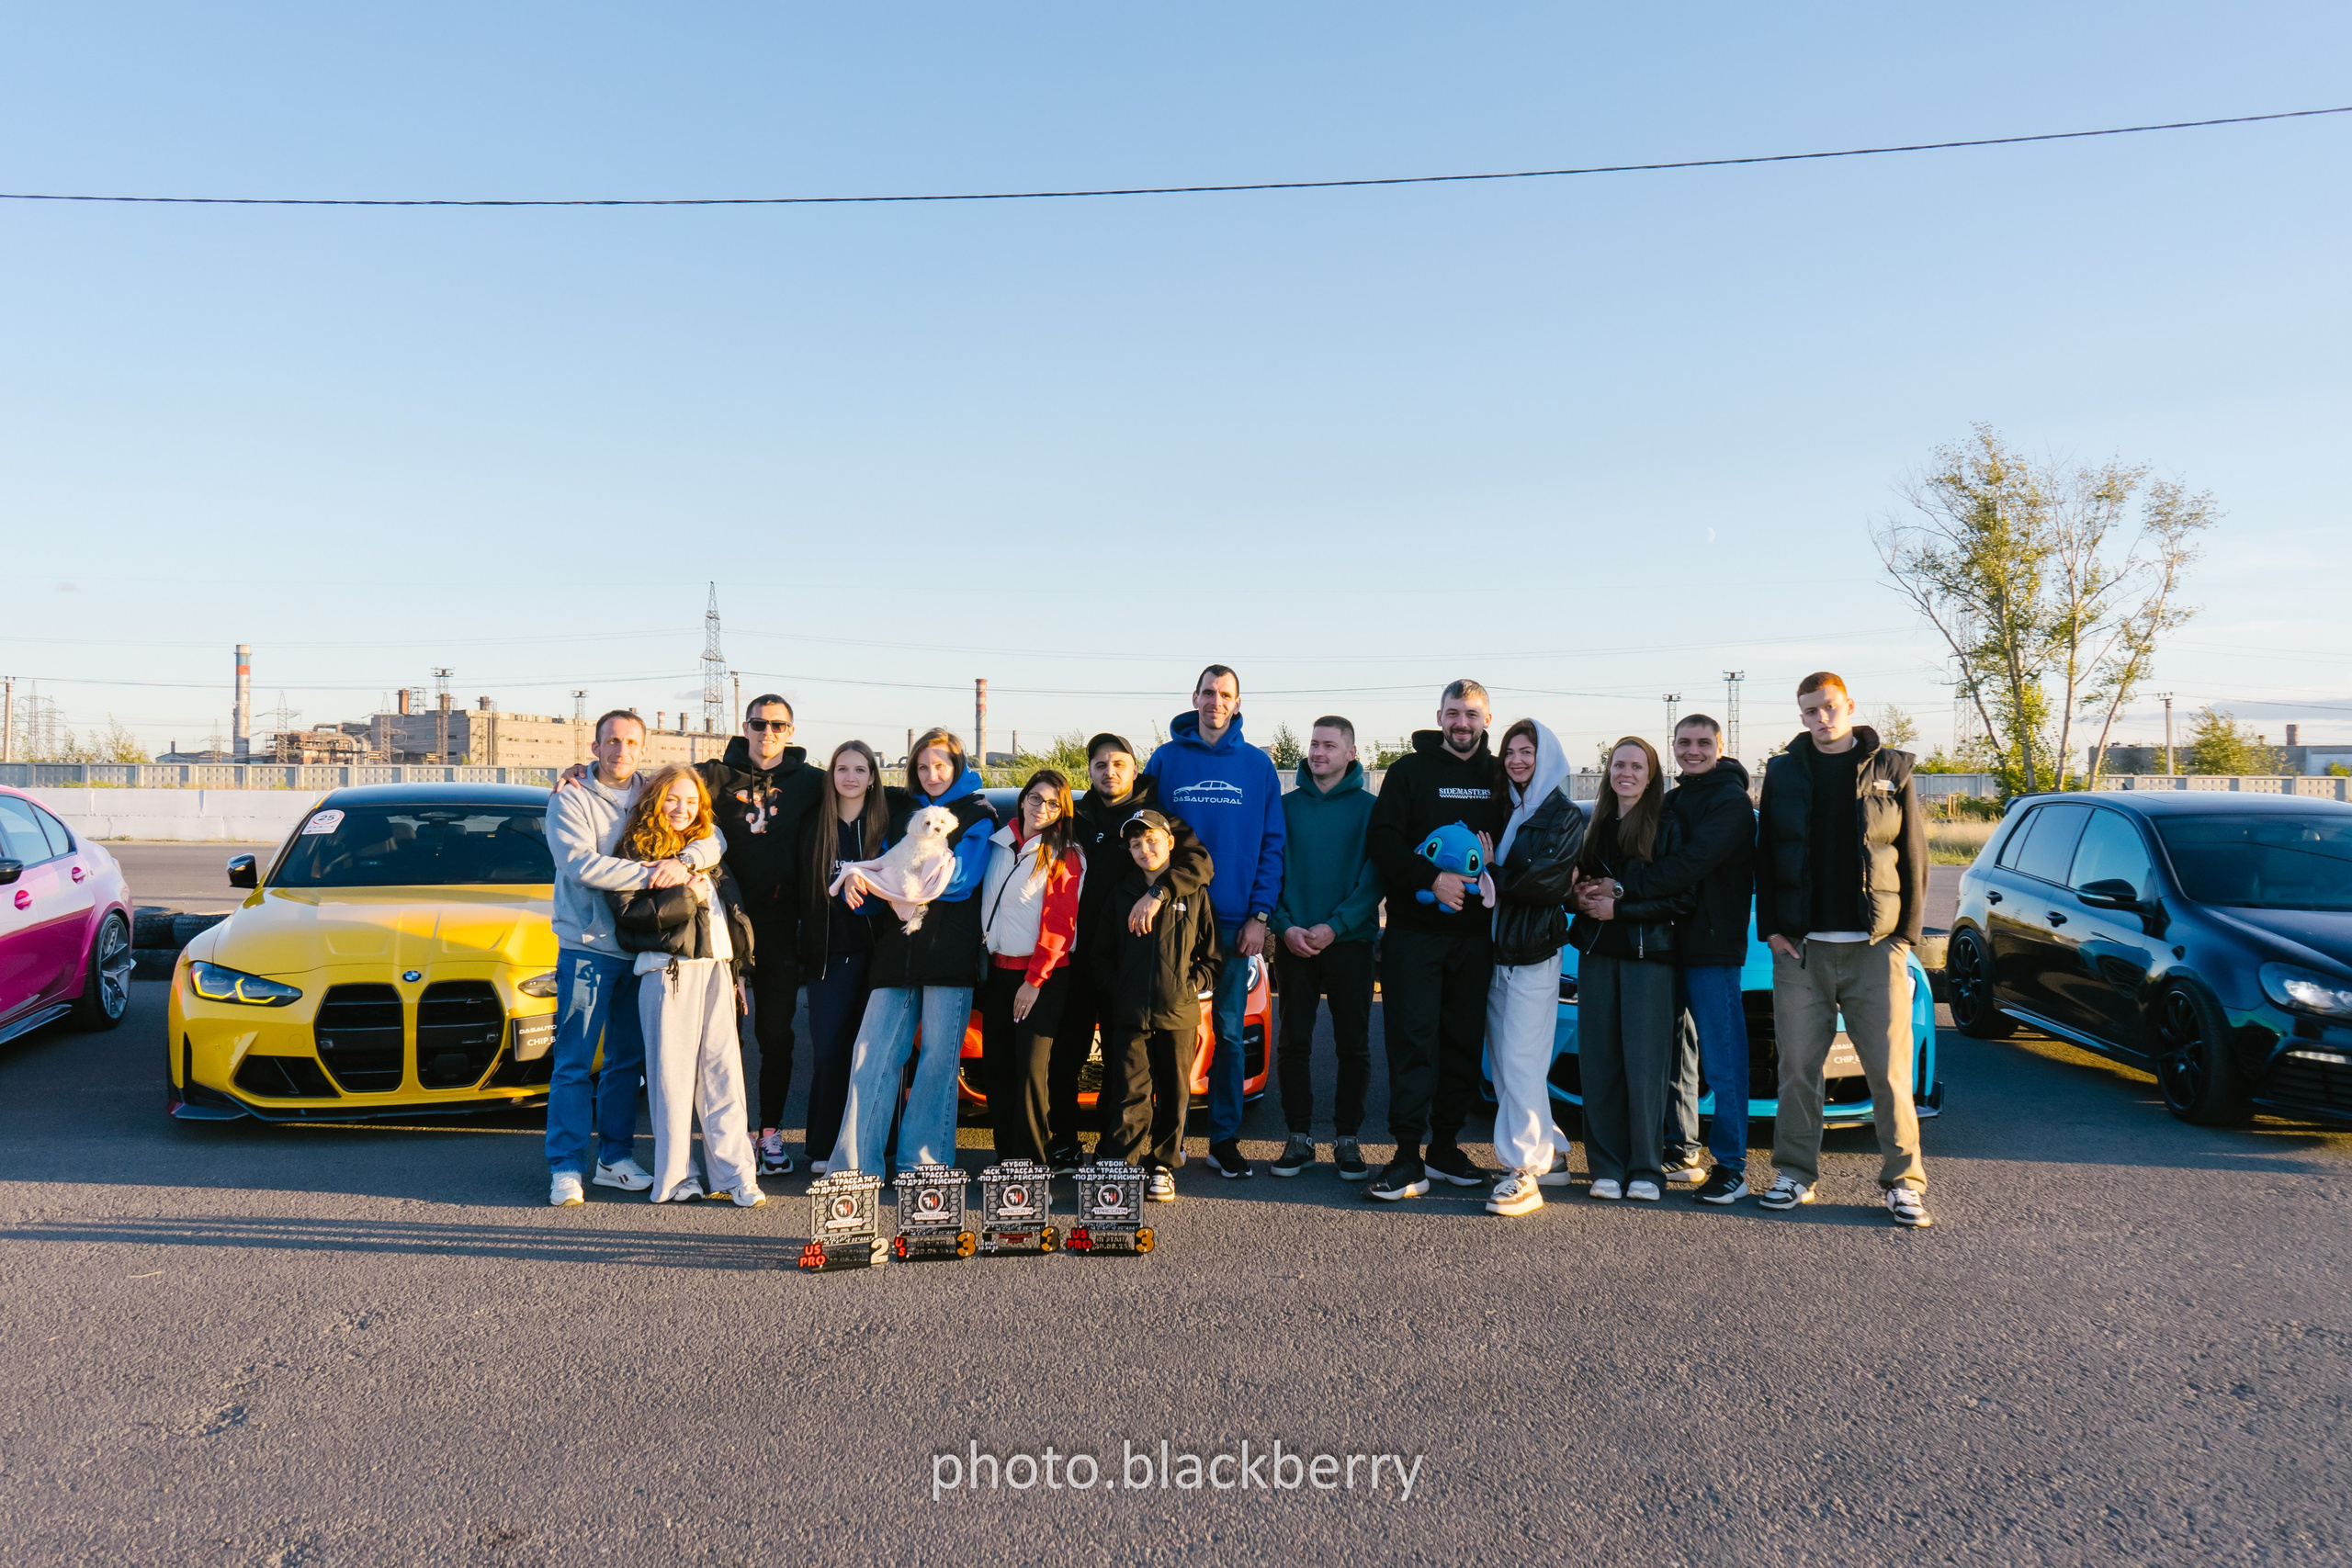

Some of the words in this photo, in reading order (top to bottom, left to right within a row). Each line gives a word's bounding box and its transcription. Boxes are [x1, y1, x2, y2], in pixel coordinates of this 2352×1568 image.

[1439, 787, 1491, 795] SIDEMASTERS
[1173, 796, 1242, 805] DASAUTOURAL
[833, 1169, 859, 1179] КУБОК
[991, 1173, 1051, 1182] ДРЭГ-РЕЙСИНГУ
[1087, 1172, 1147, 1181] ДРЭГ-РЕЙСИНГУ
[814, 1179, 829, 1188] АСК
[907, 1177, 968, 1186] ДРЭГ-РЕЙСИНГУ
[808, 1187, 820, 1195] ПО
[820, 1181, 882, 1194] ДРЭГ-РЕЙСИНГУ
[1071, 1229, 1088, 1238] US
[957, 1232, 976, 1257] 3
[1041, 1227, 1060, 1252] 3
[1067, 1239, 1092, 1249] PRO
[1136, 1228, 1154, 1253] 3
[805, 1244, 821, 1256] US
[871, 1237, 889, 1264] 2
[799, 1254, 826, 1268] PRO
